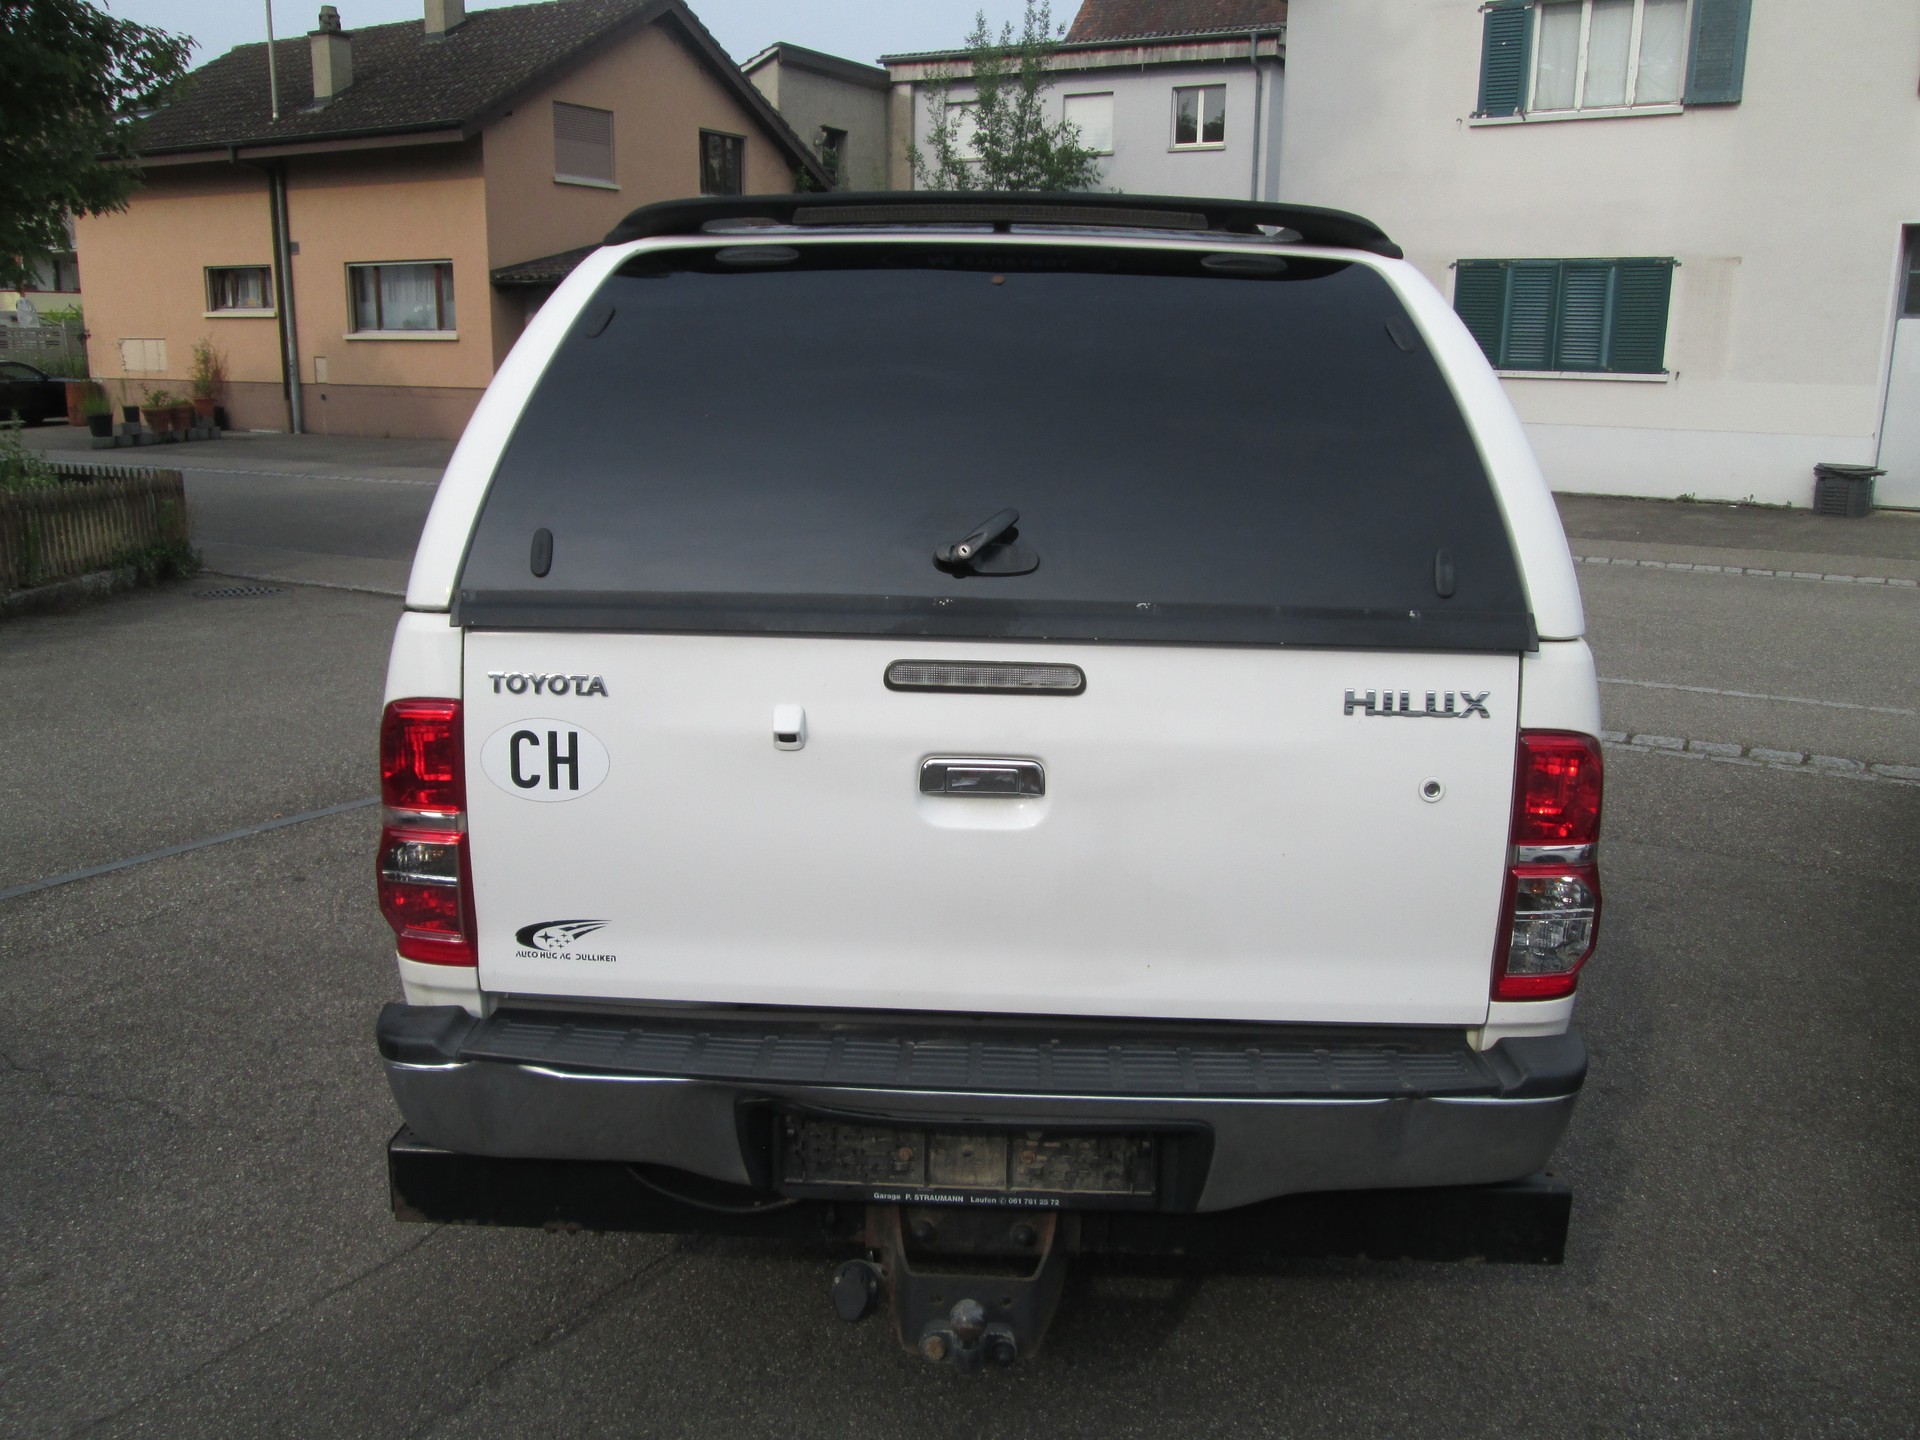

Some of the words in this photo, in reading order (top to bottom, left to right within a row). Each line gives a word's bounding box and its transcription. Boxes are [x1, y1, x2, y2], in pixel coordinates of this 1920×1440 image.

[487, 671, 609, 697] TOYOTA
[1344, 688, 1491, 719] HILUX
[510, 730, 579, 790] CH
[873, 1192, 901, 1201] Garage
[914, 1194, 964, 1203] STRAUMANN
[970, 1196, 997, 1204] Laufen
